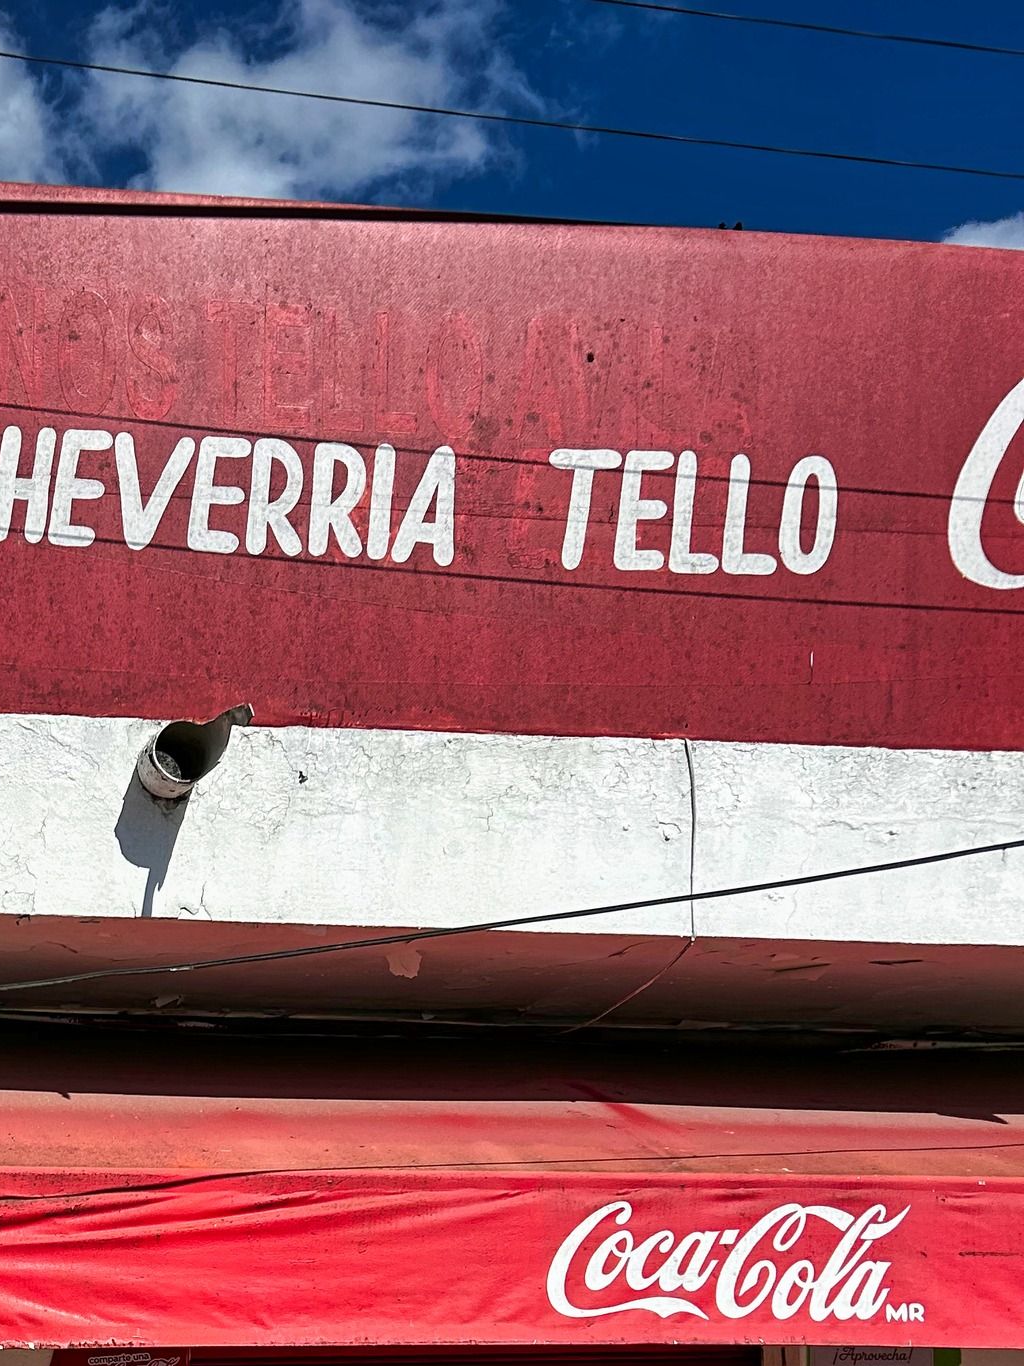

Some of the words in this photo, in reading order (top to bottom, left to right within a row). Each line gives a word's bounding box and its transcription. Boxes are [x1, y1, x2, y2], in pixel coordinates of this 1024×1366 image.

[548, 448, 839, 575] TELLO
[545, 1200, 912, 1323] Coca-Cola
[886, 1302, 926, 1324] MR
[89, 1355, 132, 1365] comparte
[133, 1353, 150, 1361] una
